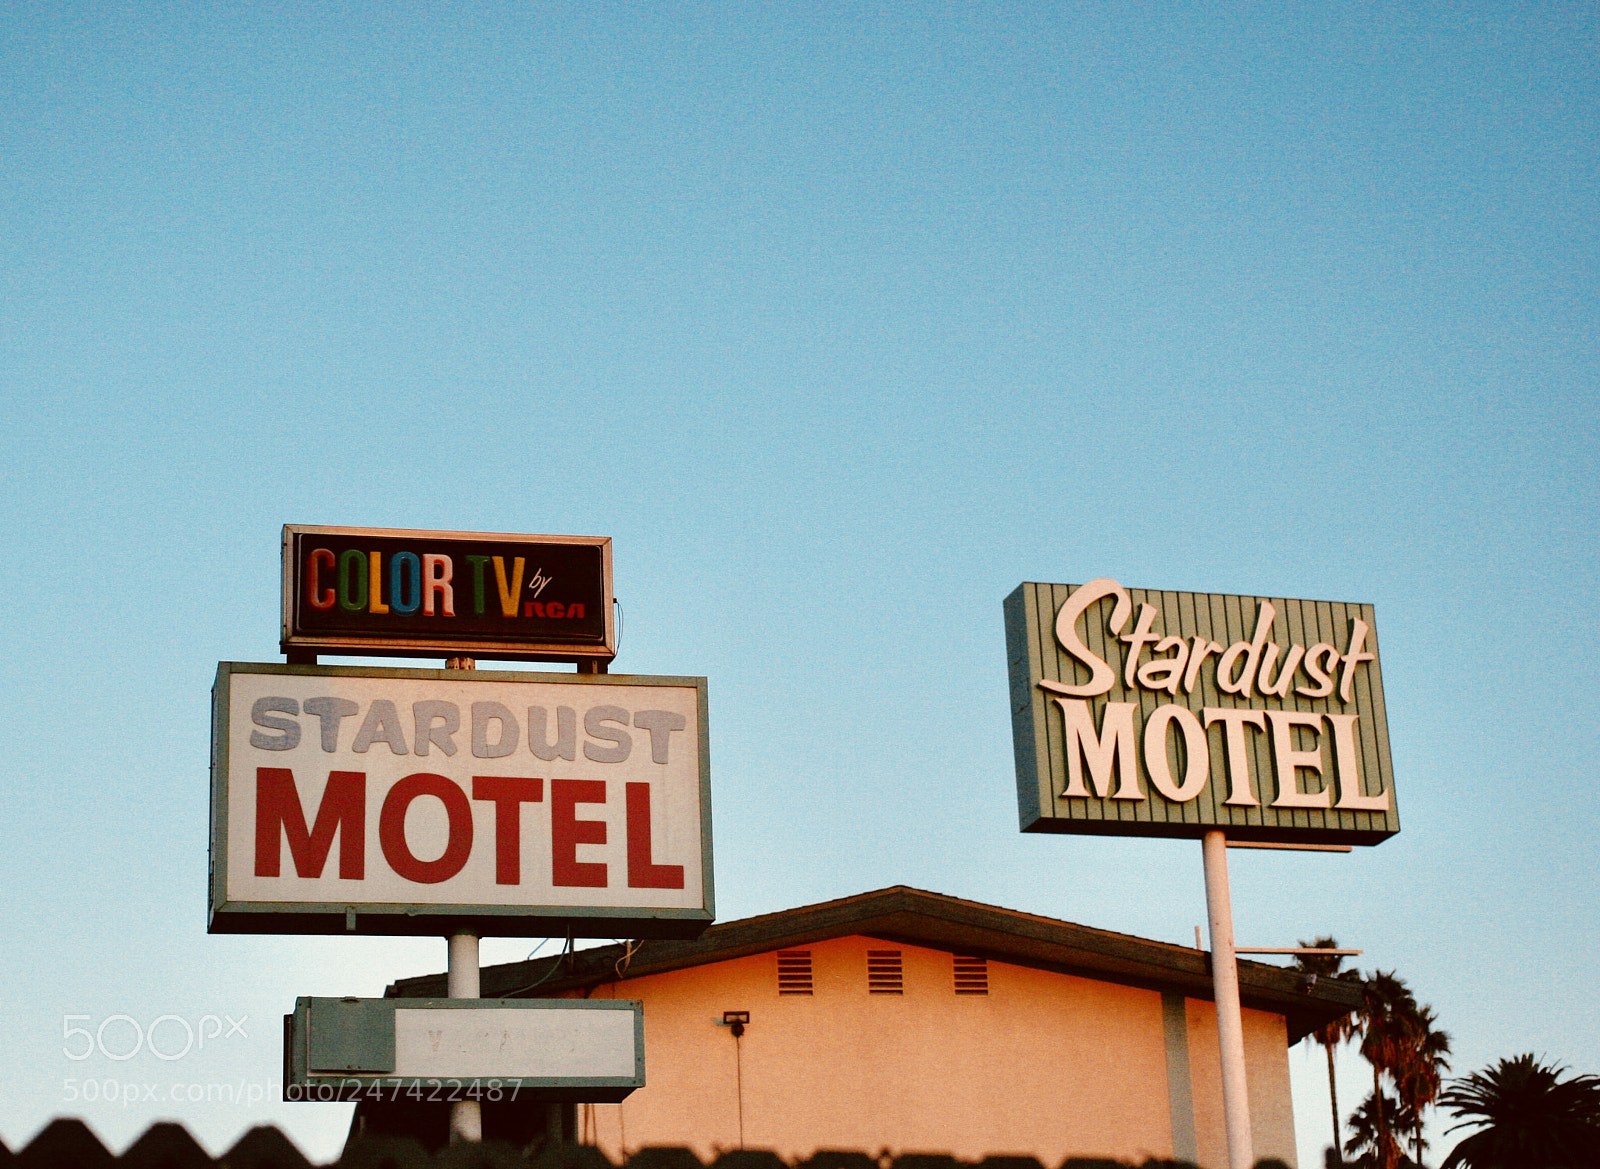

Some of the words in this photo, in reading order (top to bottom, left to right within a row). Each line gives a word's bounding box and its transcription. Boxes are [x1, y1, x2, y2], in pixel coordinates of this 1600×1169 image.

[306, 547, 456, 618] COLOR
[465, 554, 526, 618] TV
[528, 567, 553, 599] by
[523, 601, 586, 620] RCA
[1038, 577, 1376, 704] Stardust
[249, 696, 686, 765] STARDUST
[1052, 697, 1390, 812] MOTEL
[254, 767, 685, 890] MOTEL
